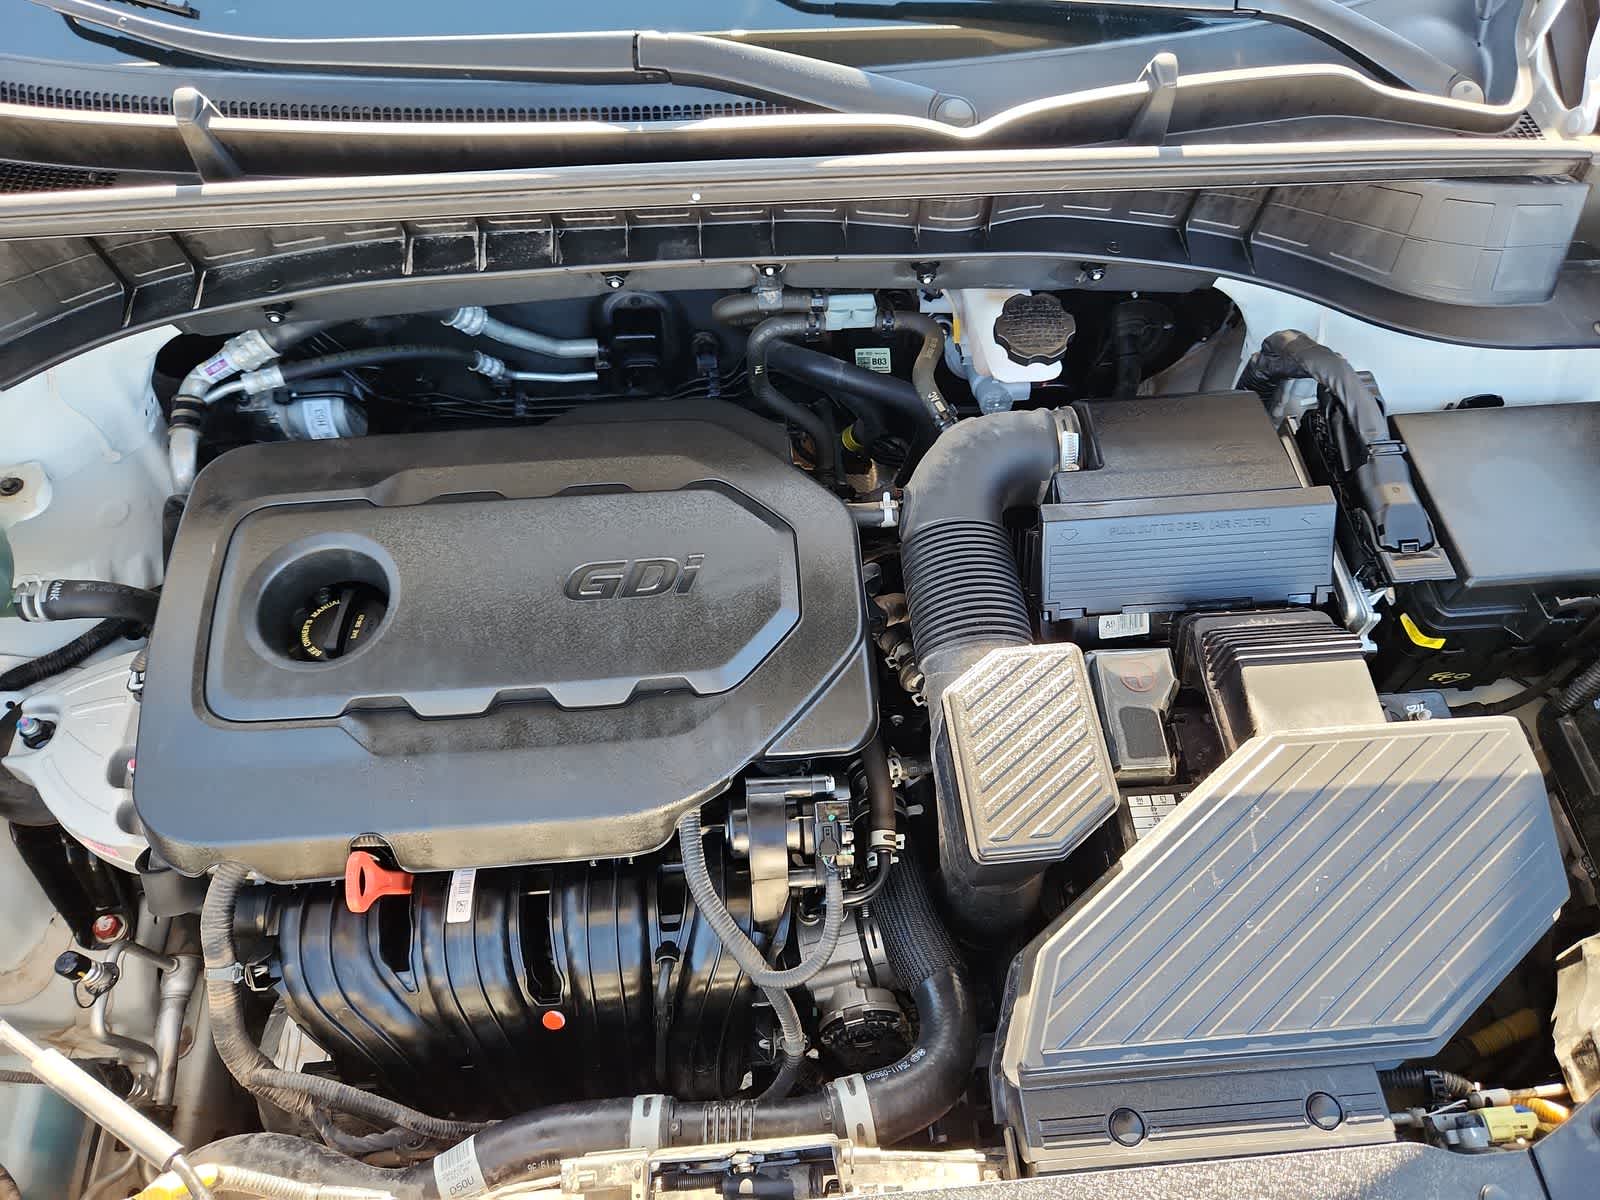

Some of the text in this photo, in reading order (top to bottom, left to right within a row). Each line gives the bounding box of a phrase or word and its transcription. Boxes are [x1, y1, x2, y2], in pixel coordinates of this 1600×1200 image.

[928, 391, 940, 402] AC
[563, 553, 705, 602] GDi
[310, 599, 341, 618] MANUAL
